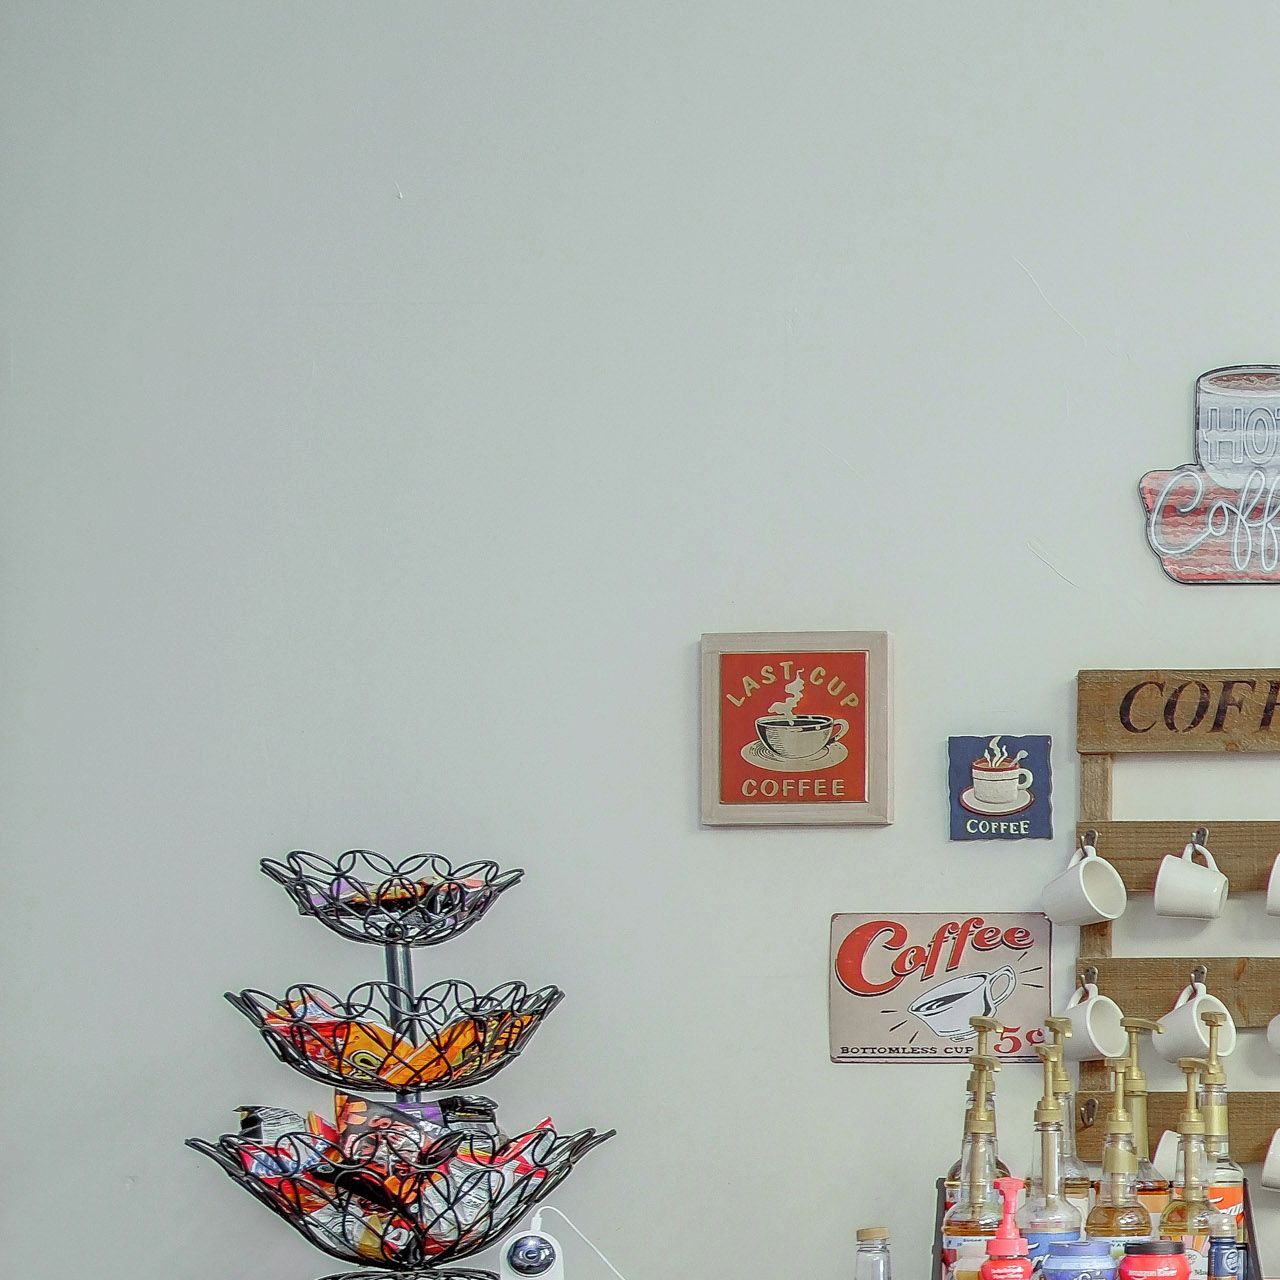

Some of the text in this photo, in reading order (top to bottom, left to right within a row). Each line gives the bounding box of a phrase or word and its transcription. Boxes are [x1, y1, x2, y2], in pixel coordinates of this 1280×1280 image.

[726, 660, 860, 710] LAST CUP
[741, 779, 845, 797] COFFEE
[966, 819, 1030, 834] COFFEE
[835, 916, 1035, 997] Coffee
[840, 1046, 974, 1055] BOTTOMLESS CUP
[993, 1026, 1046, 1054] 5¢
